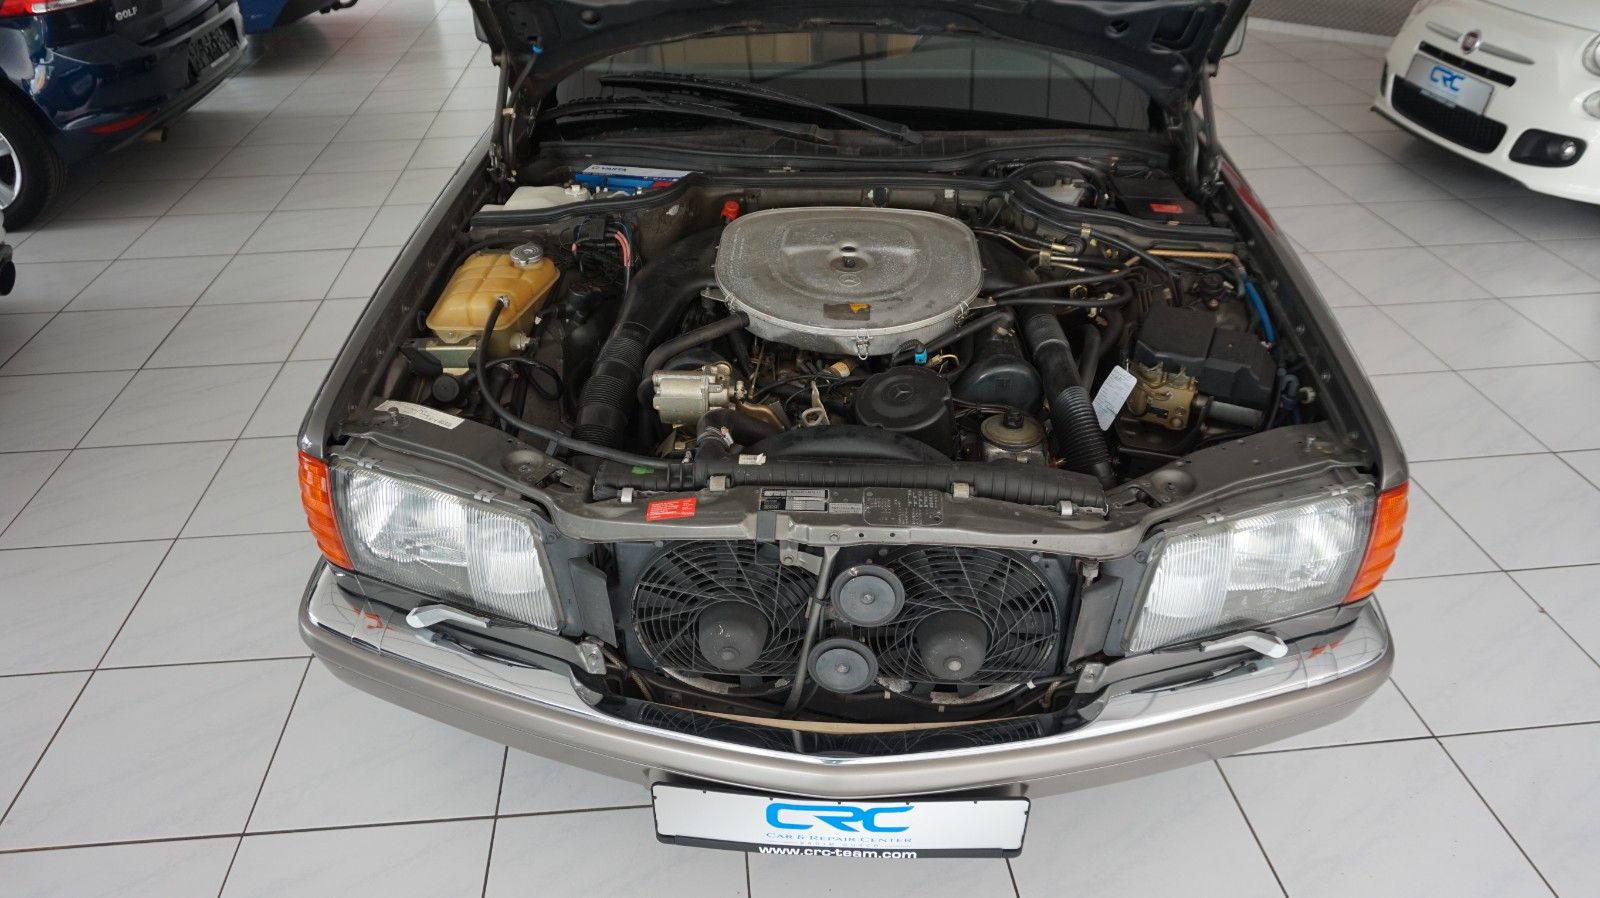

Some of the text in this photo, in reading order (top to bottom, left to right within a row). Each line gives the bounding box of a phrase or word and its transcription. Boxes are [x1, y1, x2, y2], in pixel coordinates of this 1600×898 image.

[115, 6, 137, 21] GOLF
[1430, 65, 1465, 91] CRC
[766, 803, 915, 832] CRC
[766, 832, 793, 840] CAR
[758, 846, 917, 859] www.crc-team.com
